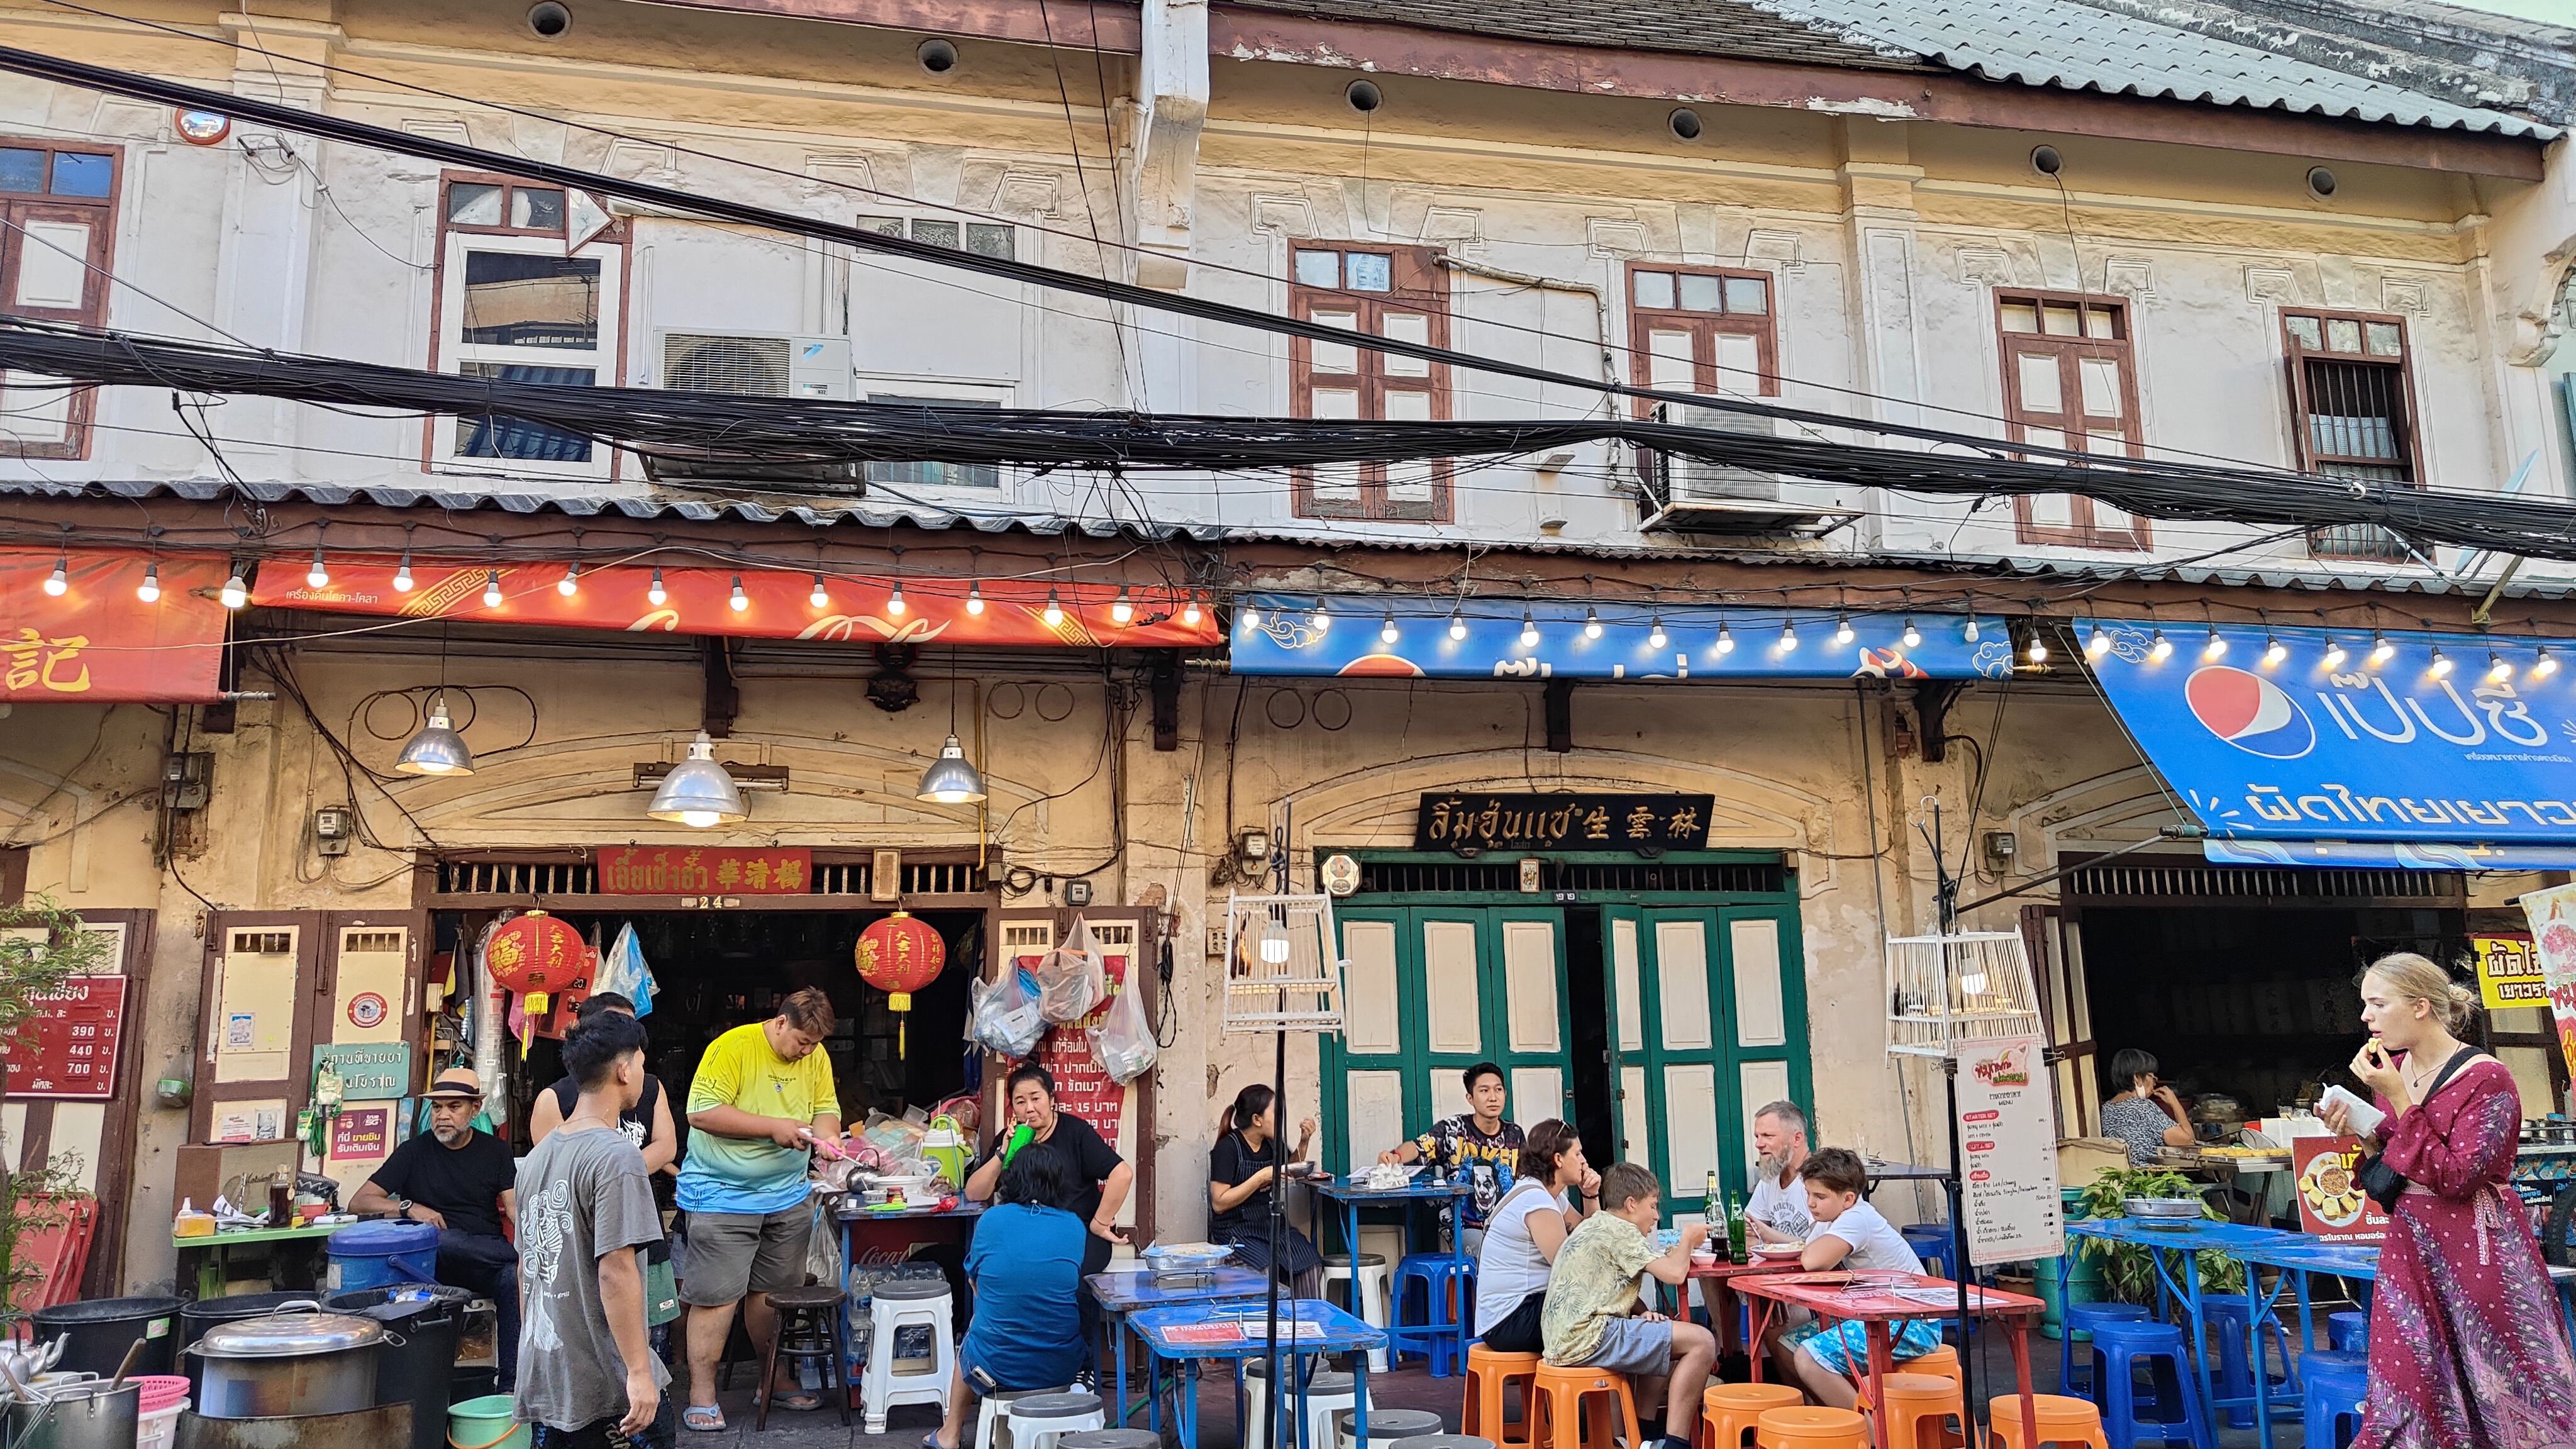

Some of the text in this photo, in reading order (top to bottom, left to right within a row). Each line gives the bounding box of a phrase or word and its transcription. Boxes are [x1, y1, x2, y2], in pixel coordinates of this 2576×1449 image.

[1, 627, 91, 692] 記
[72, 1026, 95, 1036] 390
[69, 1045, 92, 1056] 440
[1052, 1036, 1087, 1053] แก้ร้อนใน
[67, 1063, 90, 1074] 700
[1068, 1079, 1101, 1092] ขัดเบา
[1077, 1102, 1090, 1113] 15
[1094, 1102, 1118, 1113] บาท
[2365, 1211, 2390, 1225] ชิ้นละ
